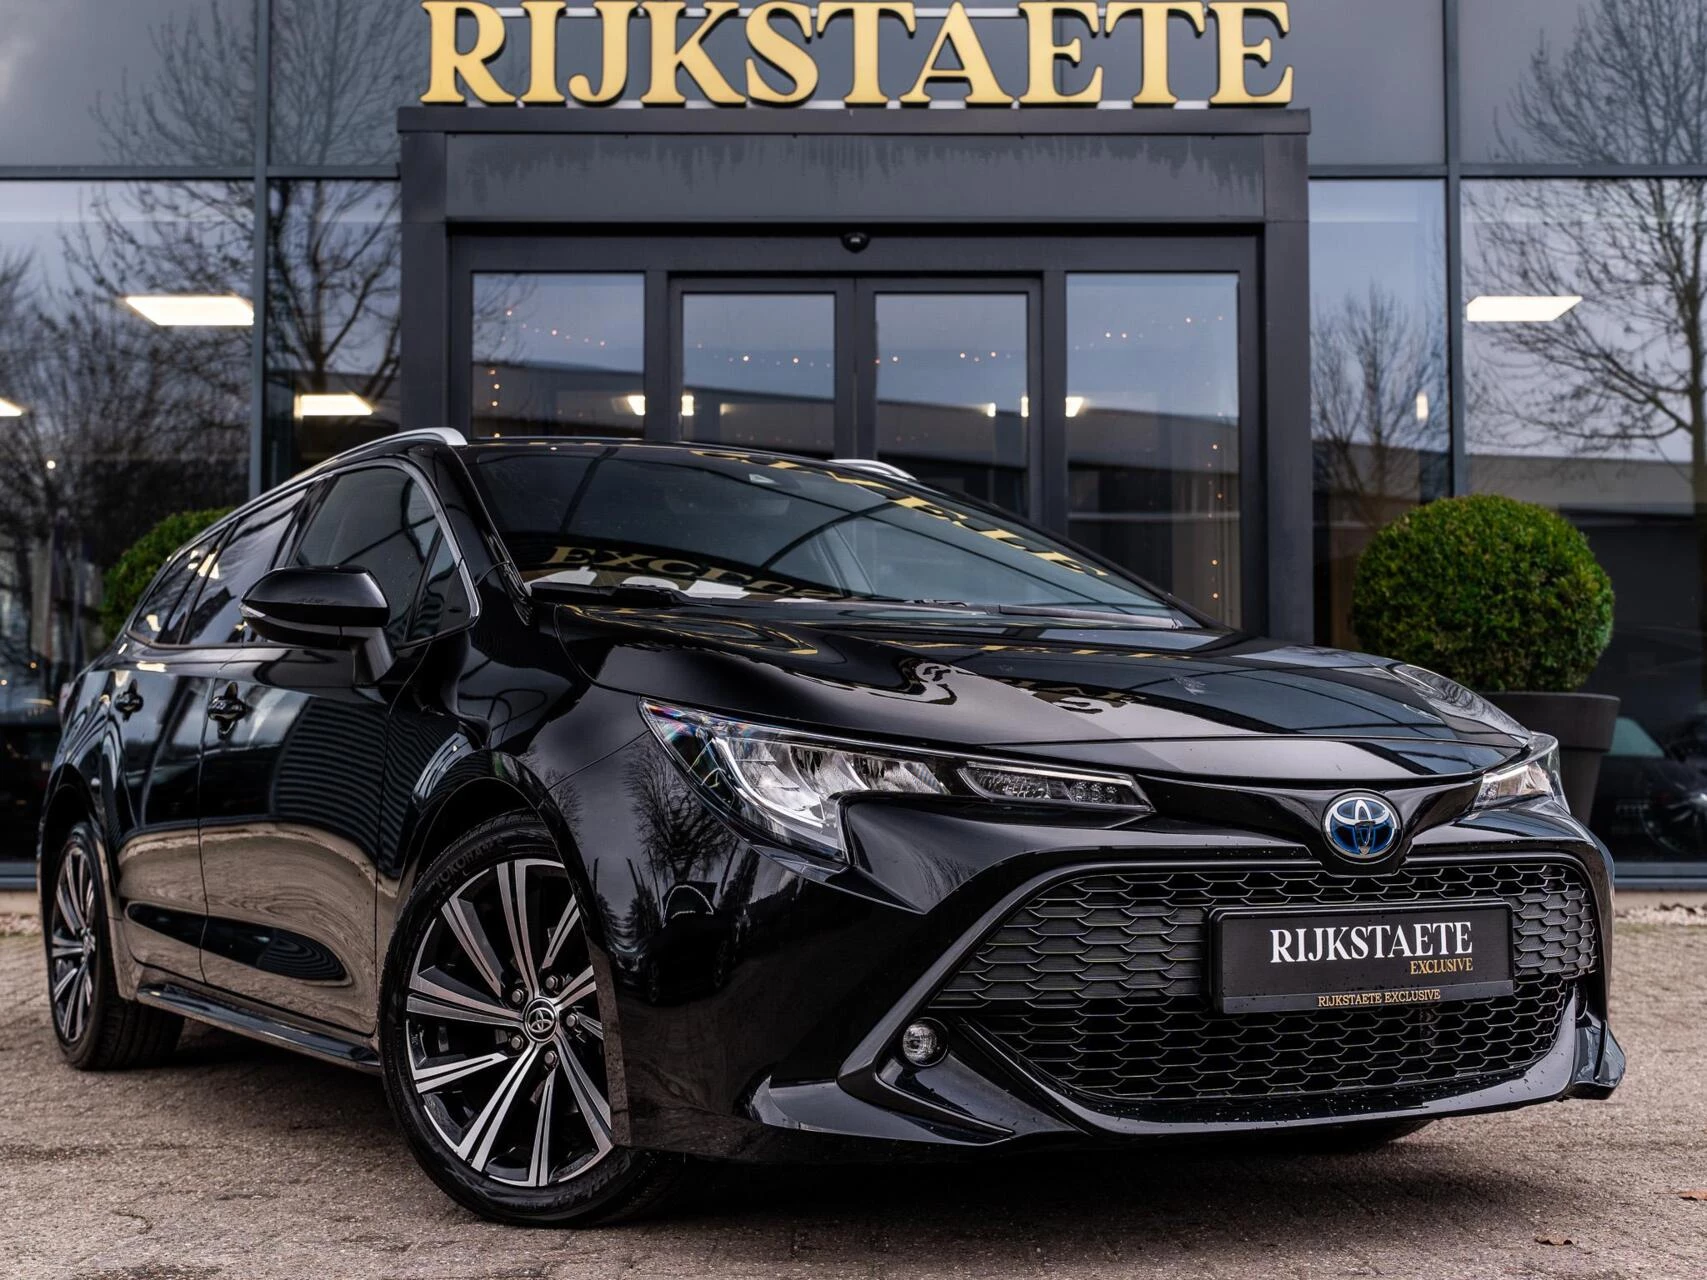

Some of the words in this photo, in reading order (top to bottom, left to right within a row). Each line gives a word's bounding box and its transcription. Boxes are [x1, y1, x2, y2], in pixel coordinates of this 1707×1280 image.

[420, 0, 1294, 108] RIJKSTAETE
[430, 838, 503, 890] YOKOHA
[1270, 921, 1473, 963] RIJKSTAETE
[1410, 957, 1473, 975] EXCLUSIVE
[1318, 991, 1382, 1007] RIJKSTAETE
[1384, 989, 1441, 1003] EXCLUSIVE
